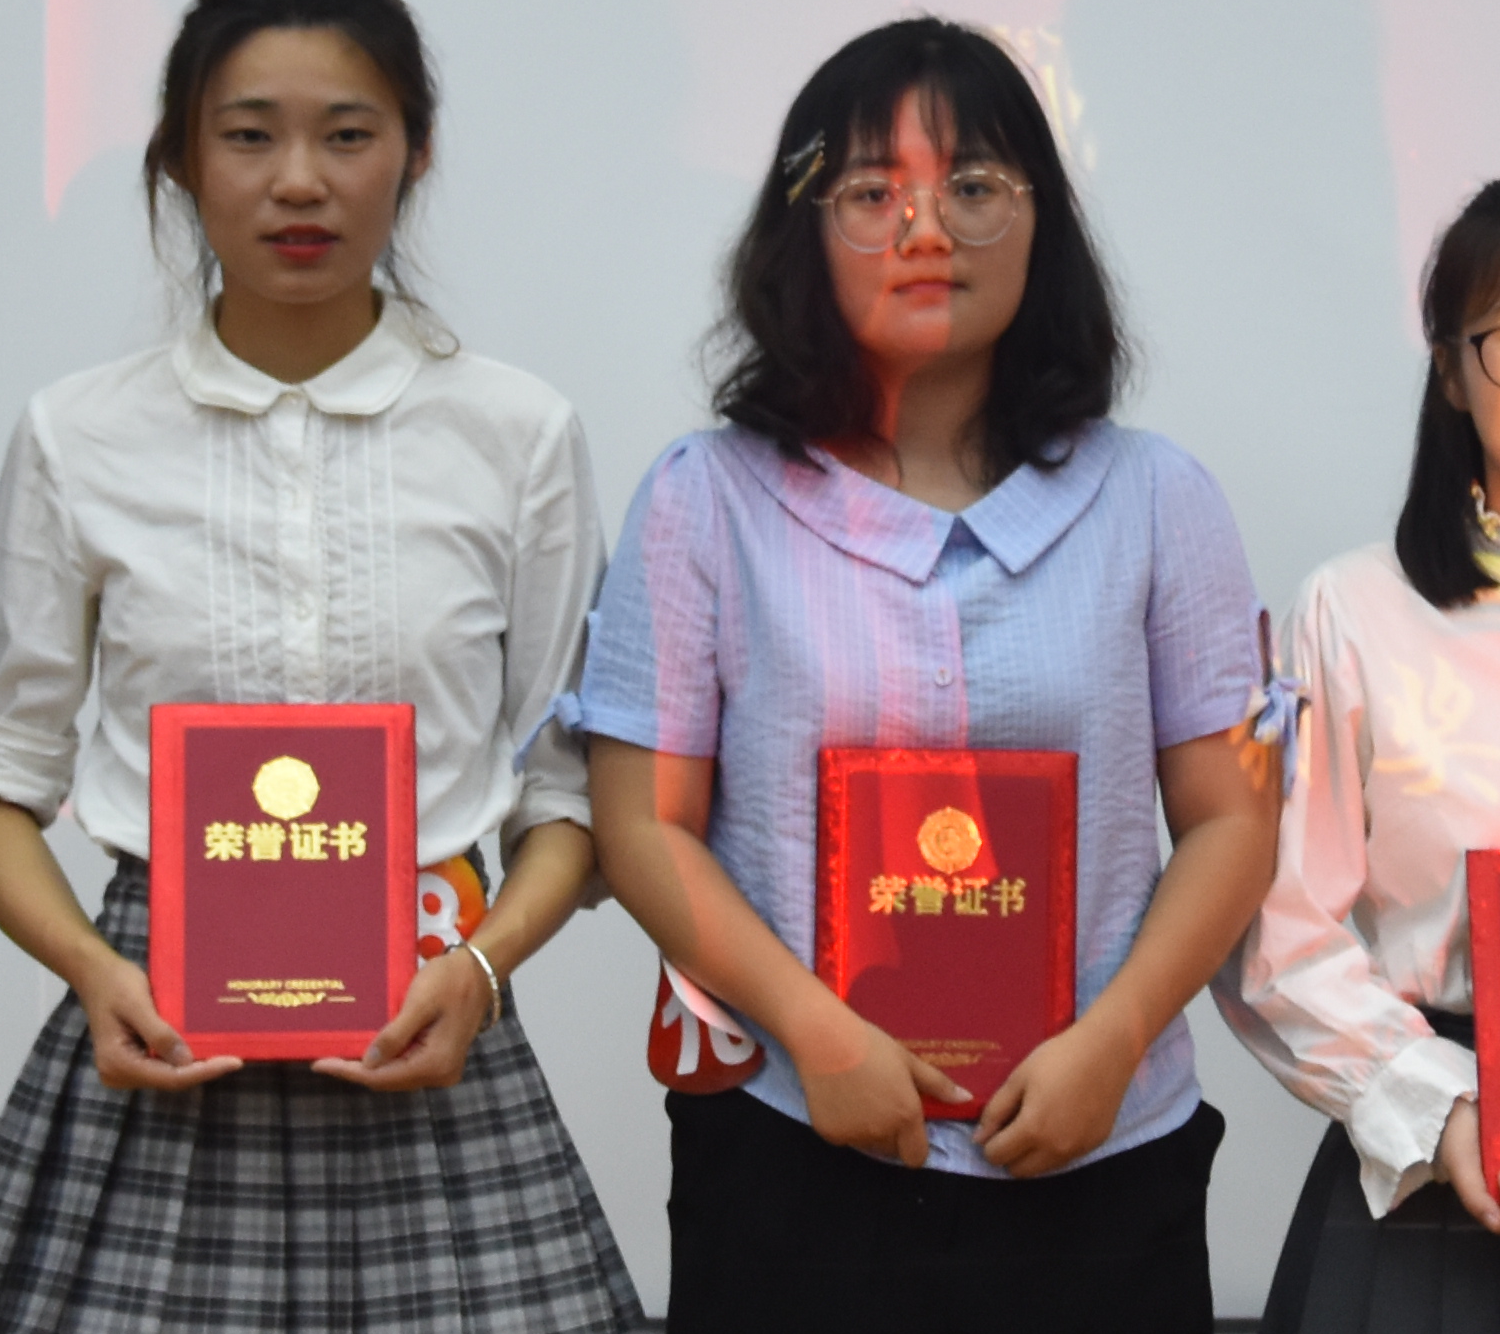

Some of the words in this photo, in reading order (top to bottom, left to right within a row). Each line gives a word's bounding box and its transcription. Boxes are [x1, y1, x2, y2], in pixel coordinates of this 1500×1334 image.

[203, 821, 368, 862] 荣誉证书
[868, 875, 1025, 916] 荣誉证书
